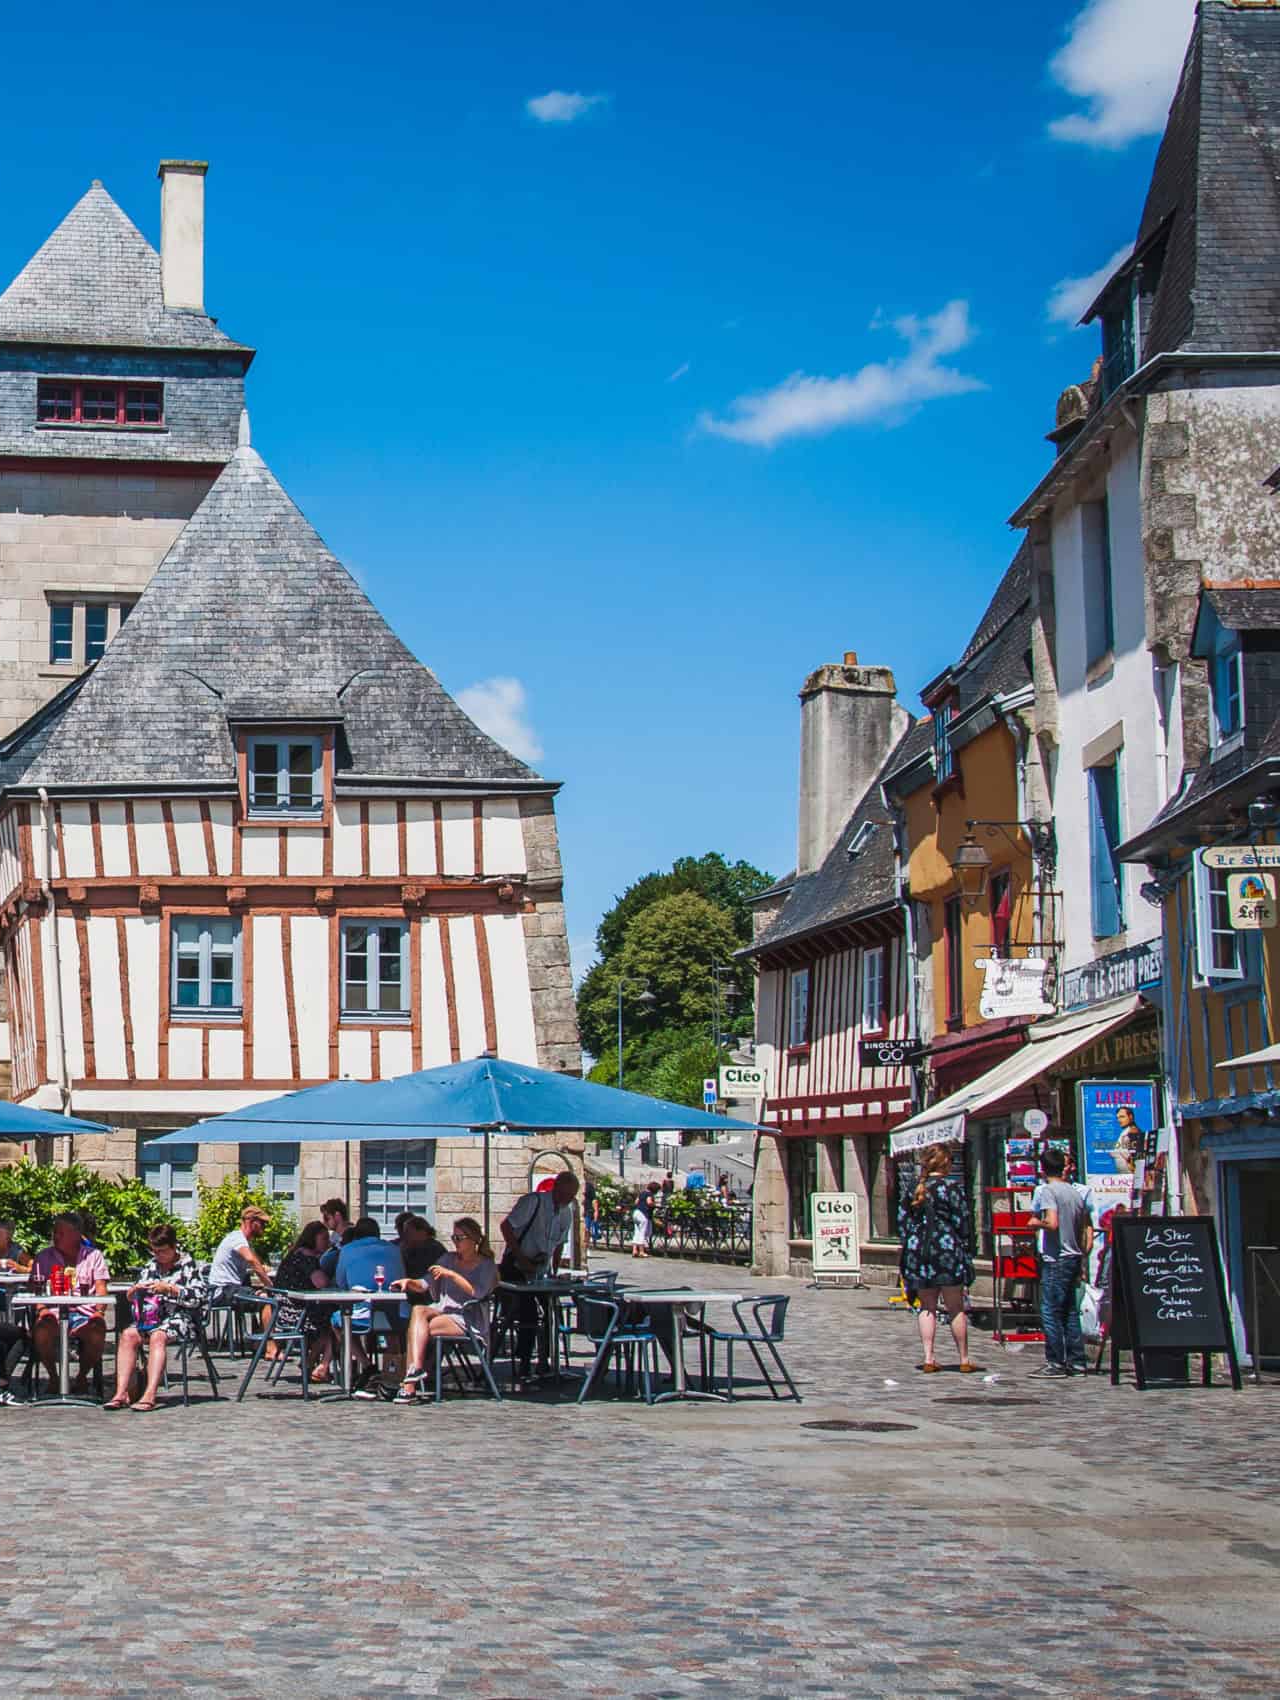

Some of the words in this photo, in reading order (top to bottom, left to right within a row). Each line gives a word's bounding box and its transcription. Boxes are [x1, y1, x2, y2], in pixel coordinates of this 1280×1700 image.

[1238, 904, 1271, 920] Leffe
[1094, 968, 1106, 999] LE
[816, 1200, 852, 1213] Cléo
[1145, 1227, 1159, 1243] Le
[1156, 1308, 1193, 1320] Crêpes
